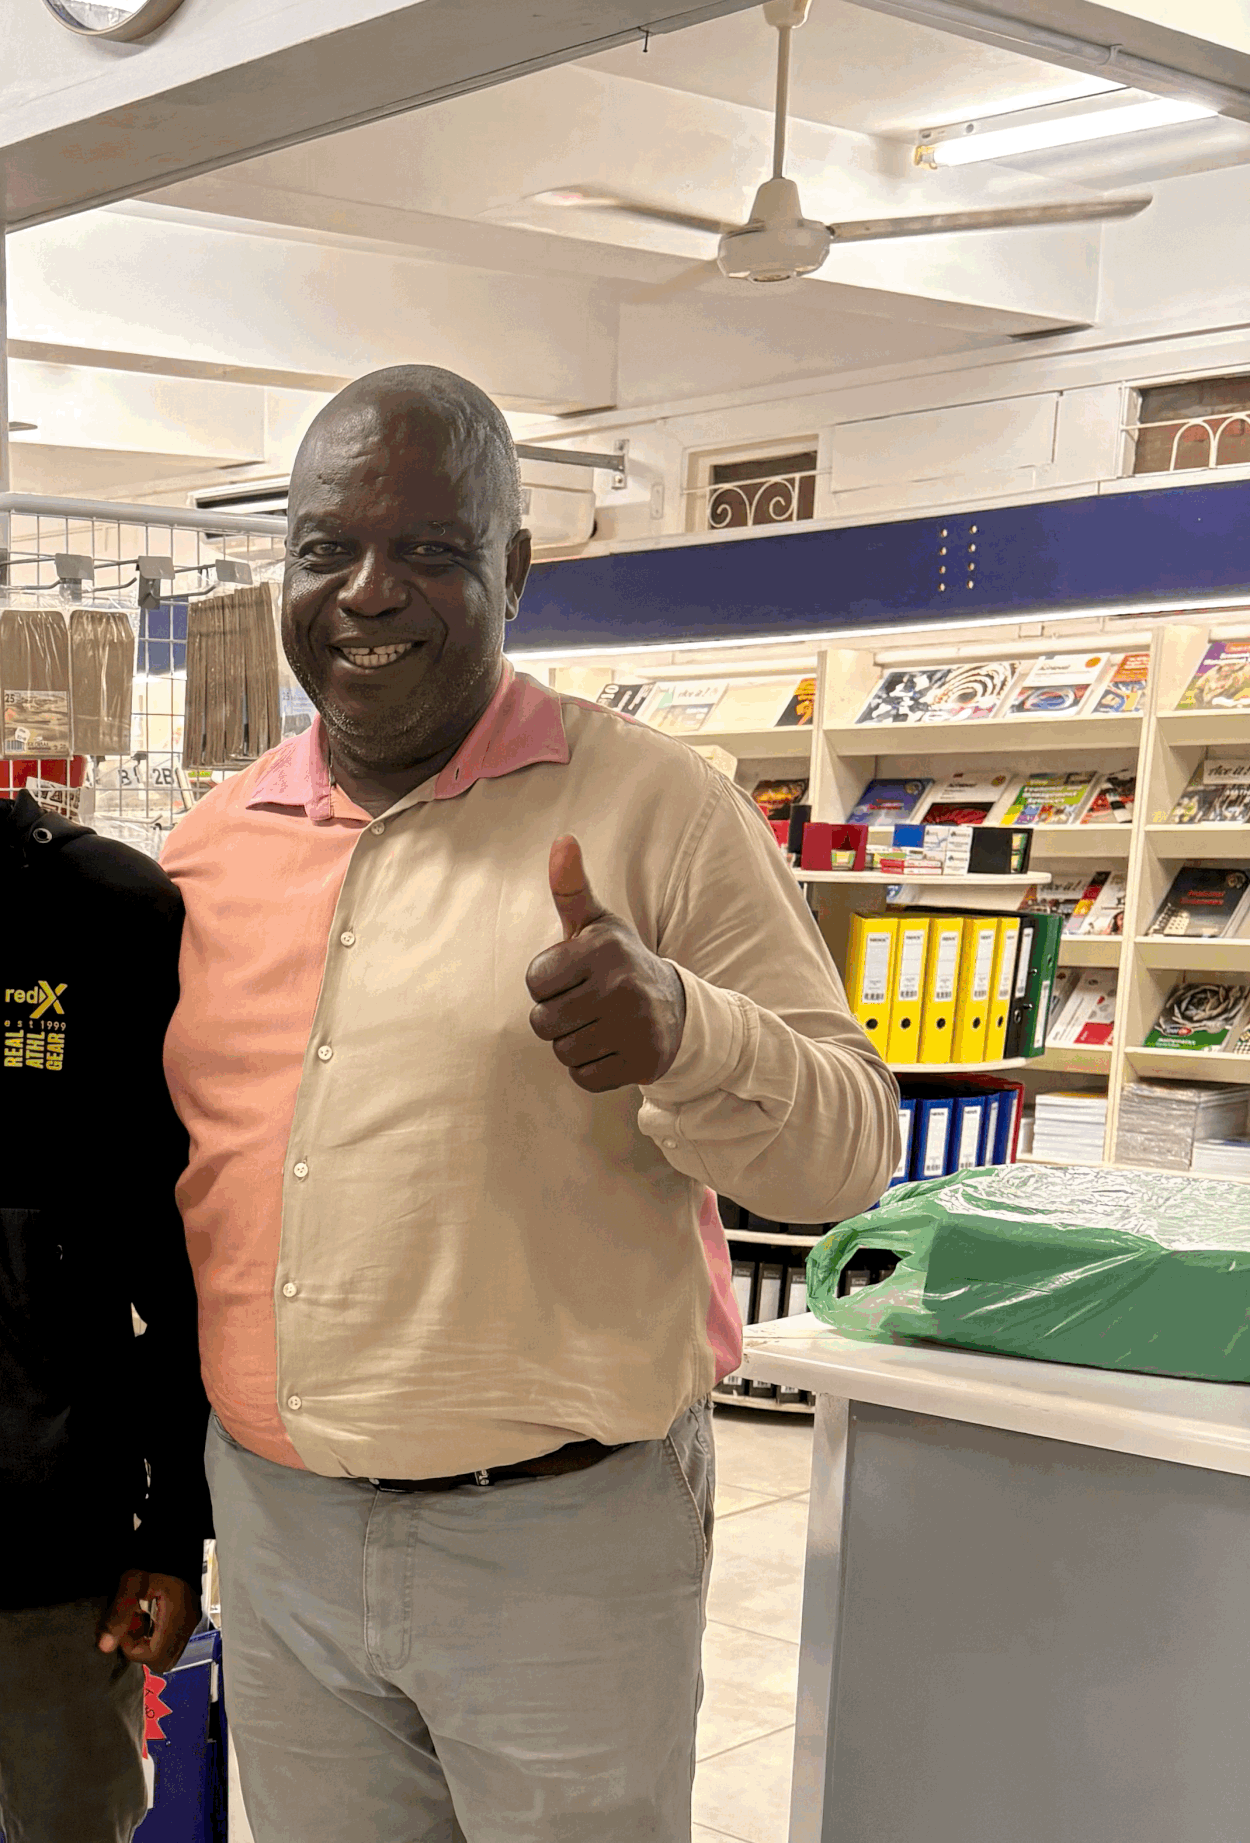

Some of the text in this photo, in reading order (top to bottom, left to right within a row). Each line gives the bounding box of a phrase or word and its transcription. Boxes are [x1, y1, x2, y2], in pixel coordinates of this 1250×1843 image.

[40, 1020, 67, 1031] 1999
[4, 1029, 24, 1067] REAL
[25, 1031, 45, 1069] ATHL
[45, 1032, 65, 1071] GEAR
